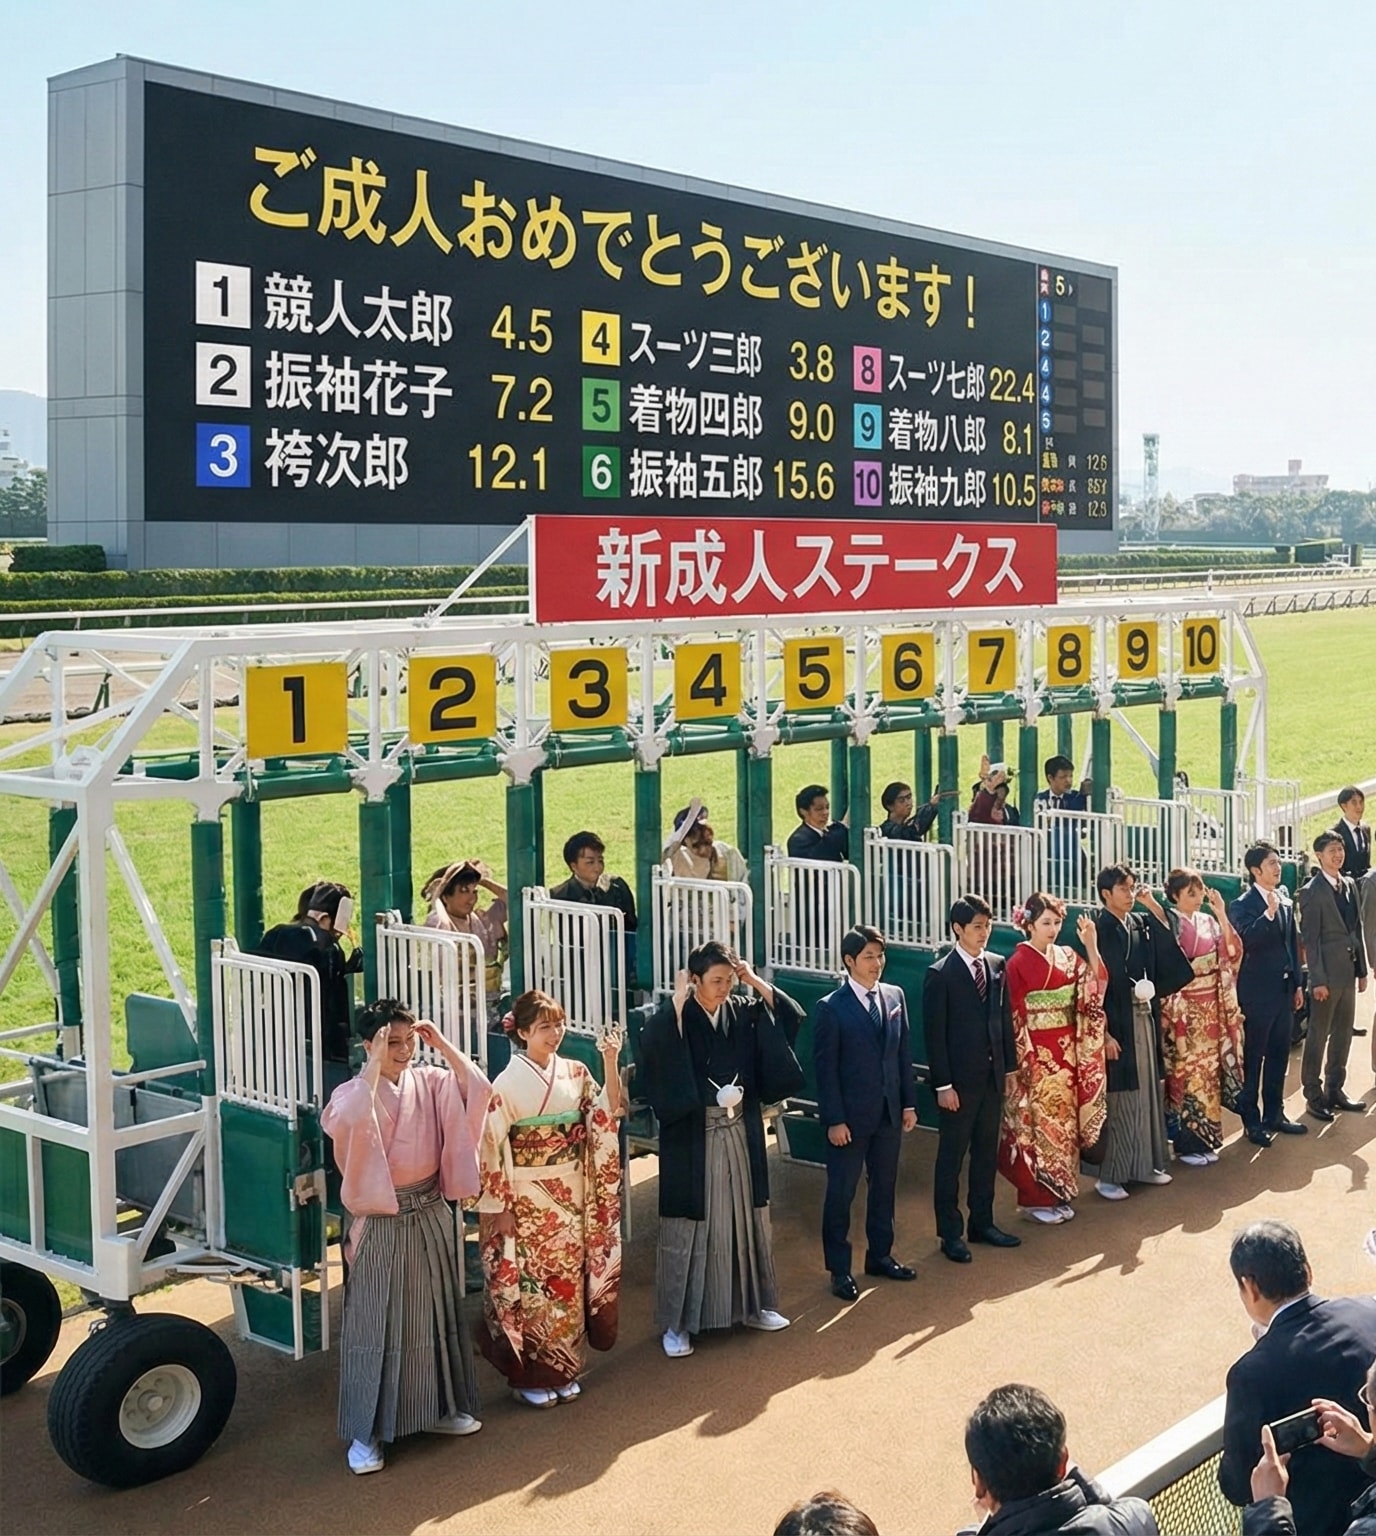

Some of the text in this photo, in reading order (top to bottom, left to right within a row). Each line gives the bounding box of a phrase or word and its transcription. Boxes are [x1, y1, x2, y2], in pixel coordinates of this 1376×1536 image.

[250, 147, 974, 328] ご成人おめでとうございます！
[213, 272, 553, 354] 1 競人太郎 4.5
[1041, 329, 1050, 347] 2
[591, 322, 834, 383] 4 スーツ三郎 3.8
[861, 354, 1036, 404] 8 スーツ七郎 22.4
[209, 350, 553, 422] 2 振袖花子 7.2
[592, 382, 834, 442] 5 着物四郎 9.0
[209, 427, 546, 491] 3 袴次郎 12.1
[860, 407, 1033, 456] 9 着物八郎 8.1
[591, 447, 835, 501] 6 振袖五郎 15.6
[856, 468, 881, 500] 10
[888, 462, 987, 509] 振袖九郎
[992, 472, 1036, 507] 10.5
[595, 526, 1024, 608] 新成人ステークス
[798, 646, 831, 700] 5
[893, 642, 923, 692] 6
[978, 637, 1005, 685] 7
[1057, 632, 1082, 678] 8
[1126, 628, 1149, 672] 9
[1186, 624, 1217, 668] 10
[428, 666, 477, 732] 2
[568, 658, 611, 719] 3
[689, 652, 727, 708] 4
[282, 675, 306, 744] 1
